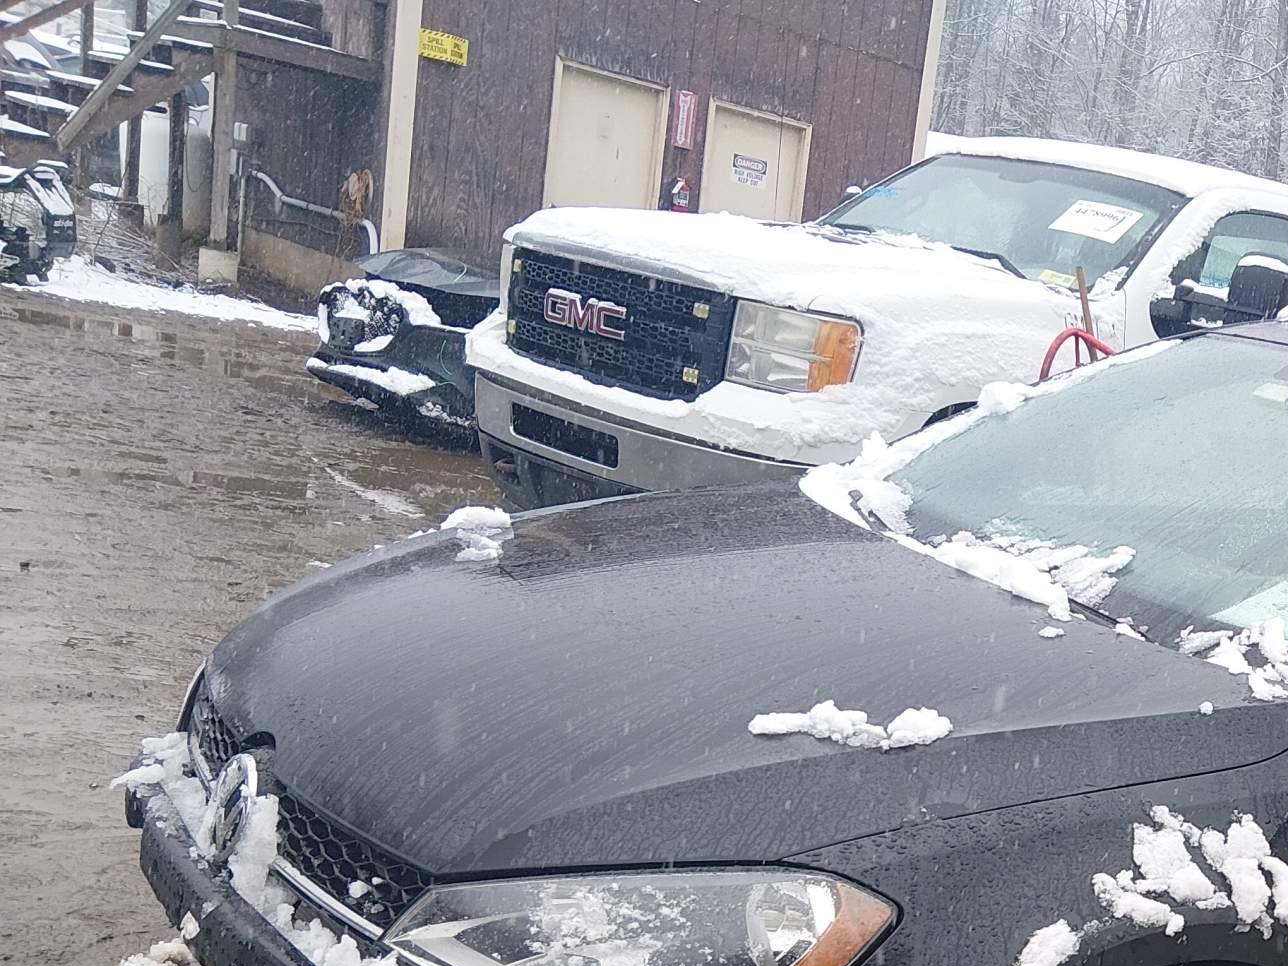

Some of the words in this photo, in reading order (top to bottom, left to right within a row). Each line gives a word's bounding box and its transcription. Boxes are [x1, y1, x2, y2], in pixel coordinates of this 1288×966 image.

[427, 36, 444, 46] SPILL
[422, 43, 448, 55] STATION
[737, 158, 764, 171] DANGER
[543, 288, 626, 341] GMC
